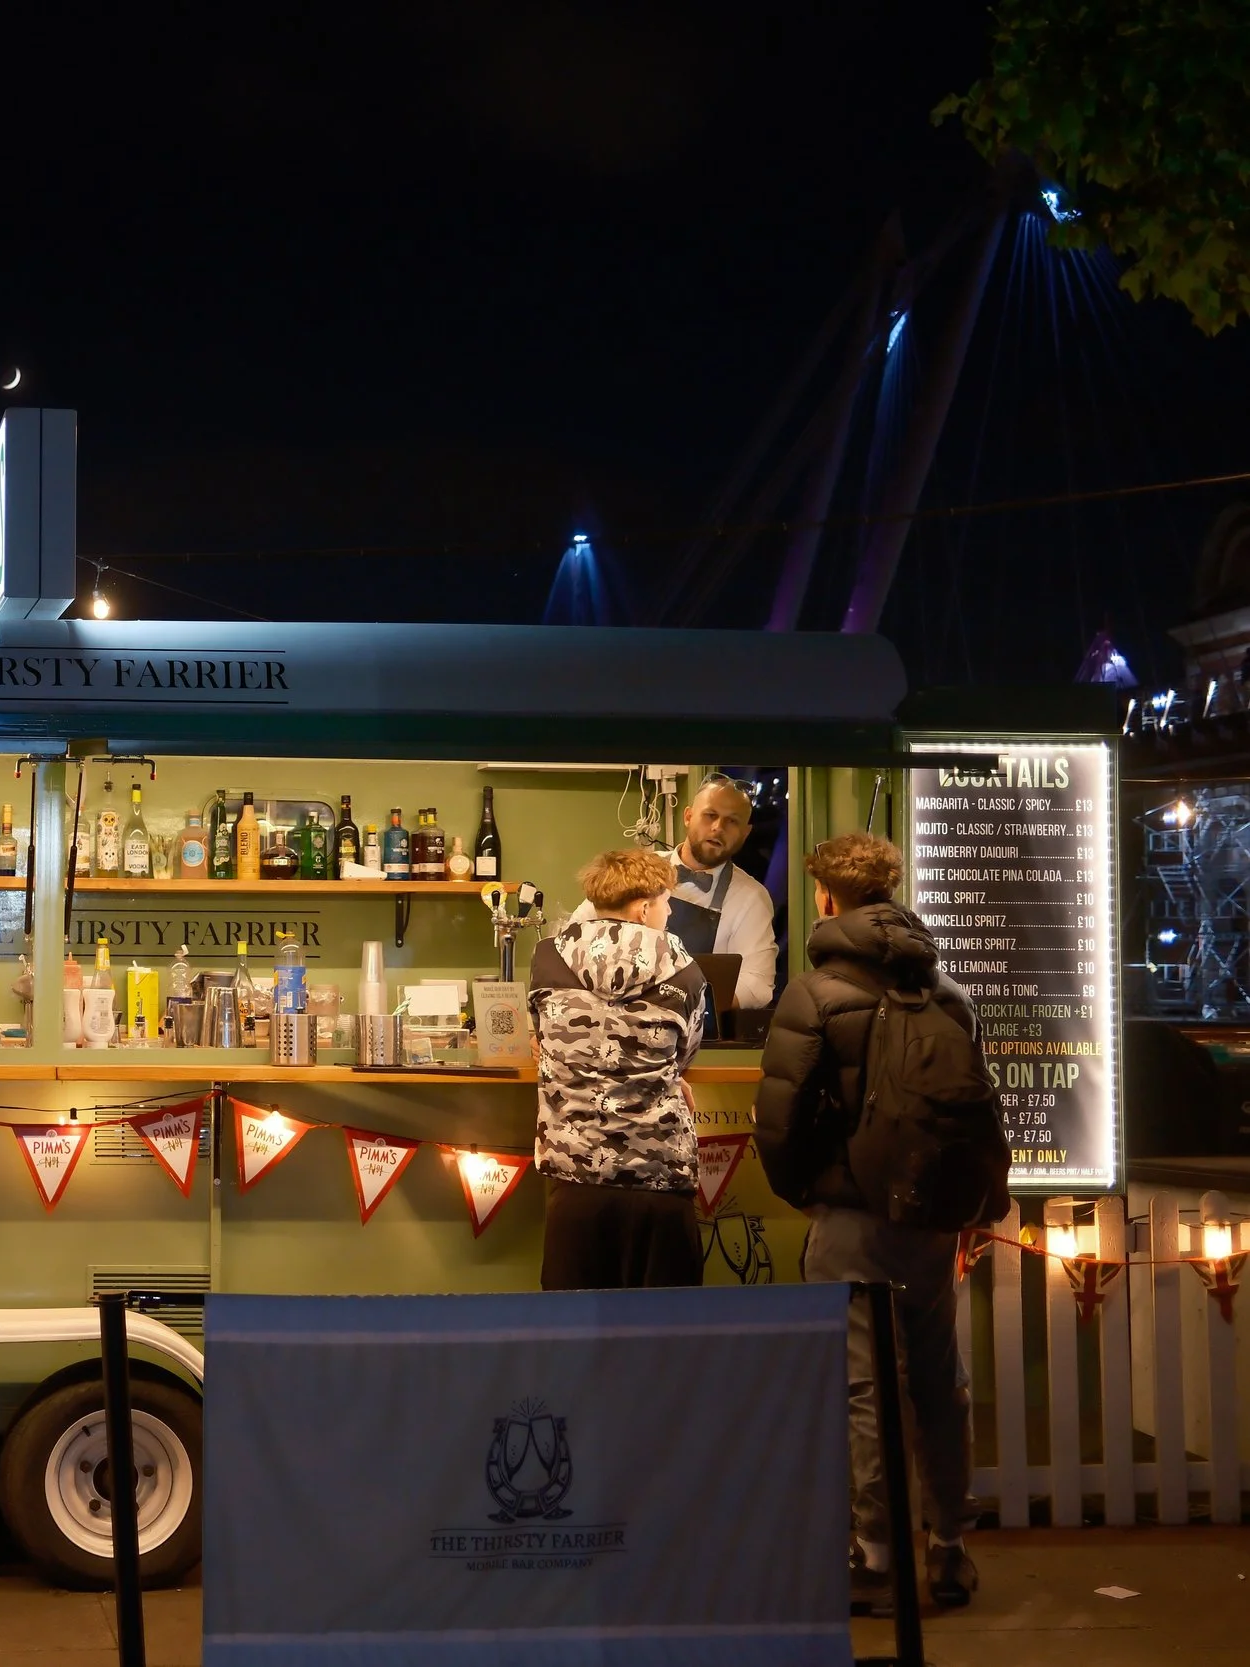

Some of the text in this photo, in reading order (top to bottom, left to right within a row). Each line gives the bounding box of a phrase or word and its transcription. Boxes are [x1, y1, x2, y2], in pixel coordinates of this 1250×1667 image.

[113, 659, 290, 690] FARRIER
[915, 797, 969, 810] MARGARITA
[977, 799, 1015, 811] CLASSIC
[1075, 800, 1093, 811] £13
[915, 823, 948, 835] MOJITO
[956, 823, 994, 835] CLASSIC
[1076, 825, 1093, 837] £13
[240, 831, 248, 855] BLEND
[915, 846, 1094, 859] STRAWBERRY DAIQUIRI £13
[916, 868, 1094, 882] WHITE CHOCOLATE PINA COLADA £13
[917, 892, 1094, 905] APEROL SPRITZ £10
[974, 915, 1006, 928] SPRITZ
[1077, 916, 1095, 928] £10
[984, 939, 1016, 951] SPRITZ
[1077, 939, 1095, 951] £10
[950, 961, 956, 972] &
[958, 961, 1008, 973] LEMONADE
[1077, 962, 1095, 974] £10
[985, 985, 1001, 997] GIN
[1003, 986, 1010, 997] &
[1012, 985, 1038, 997] TONIC
[980, 1004, 1093, 1018] COCKTAIL FROZEN +£1
[986, 1024, 1042, 1037] LARGE +£3
[1000, 1042, 1043, 1055] OPTIONS
[1046, 1042, 1102, 1056] AVAILABLE
[1006, 1063, 1034, 1088] ON
[1040, 1063, 1080, 1089] TAP
[1000, 1094, 1055, 1106] GER £7.50
[1019, 1113, 1047, 1125] £7.50
[151, 1118, 192, 1142] PIMM'S
[245, 1122, 284, 1147] PIMM'S
[1023, 1130, 1052, 1143] £7.50
[32, 1137, 71, 1155] PIMM'S
[358, 1144, 397, 1166] PIMM'S
[1037, 1150, 1067, 1163] ONLY
[430, 1530, 625, 1552] THE THIRSTY FARRIER
[467, 1558, 593, 1571] MOBILE BAR COMPANY
